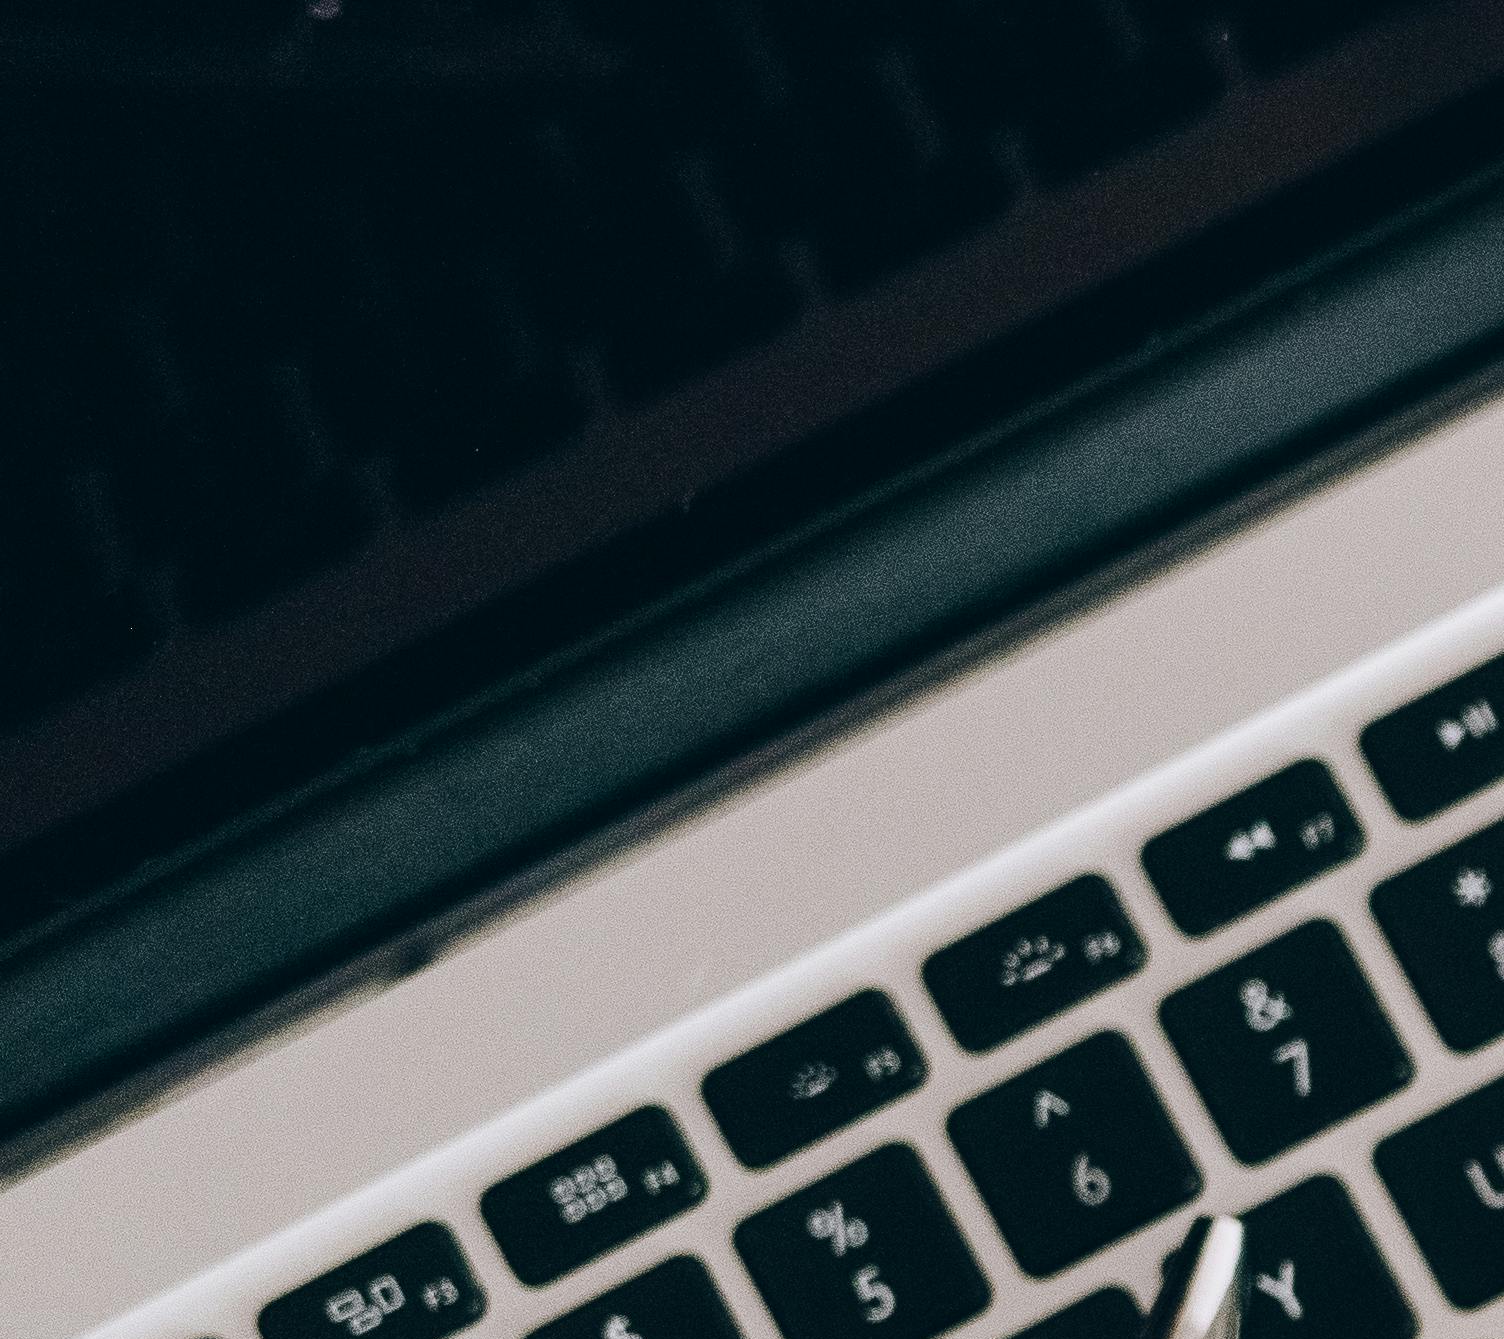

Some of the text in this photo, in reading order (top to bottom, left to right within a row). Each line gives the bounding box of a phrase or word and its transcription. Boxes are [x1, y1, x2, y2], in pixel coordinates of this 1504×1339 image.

[1241, 980, 1289, 1031] &
[1276, 1039, 1311, 1095] 7
[1073, 1156, 1111, 1205] 6
[808, 1203, 869, 1254] %
[854, 1267, 896, 1322] 5
[1257, 1262, 1302, 1319] Y
